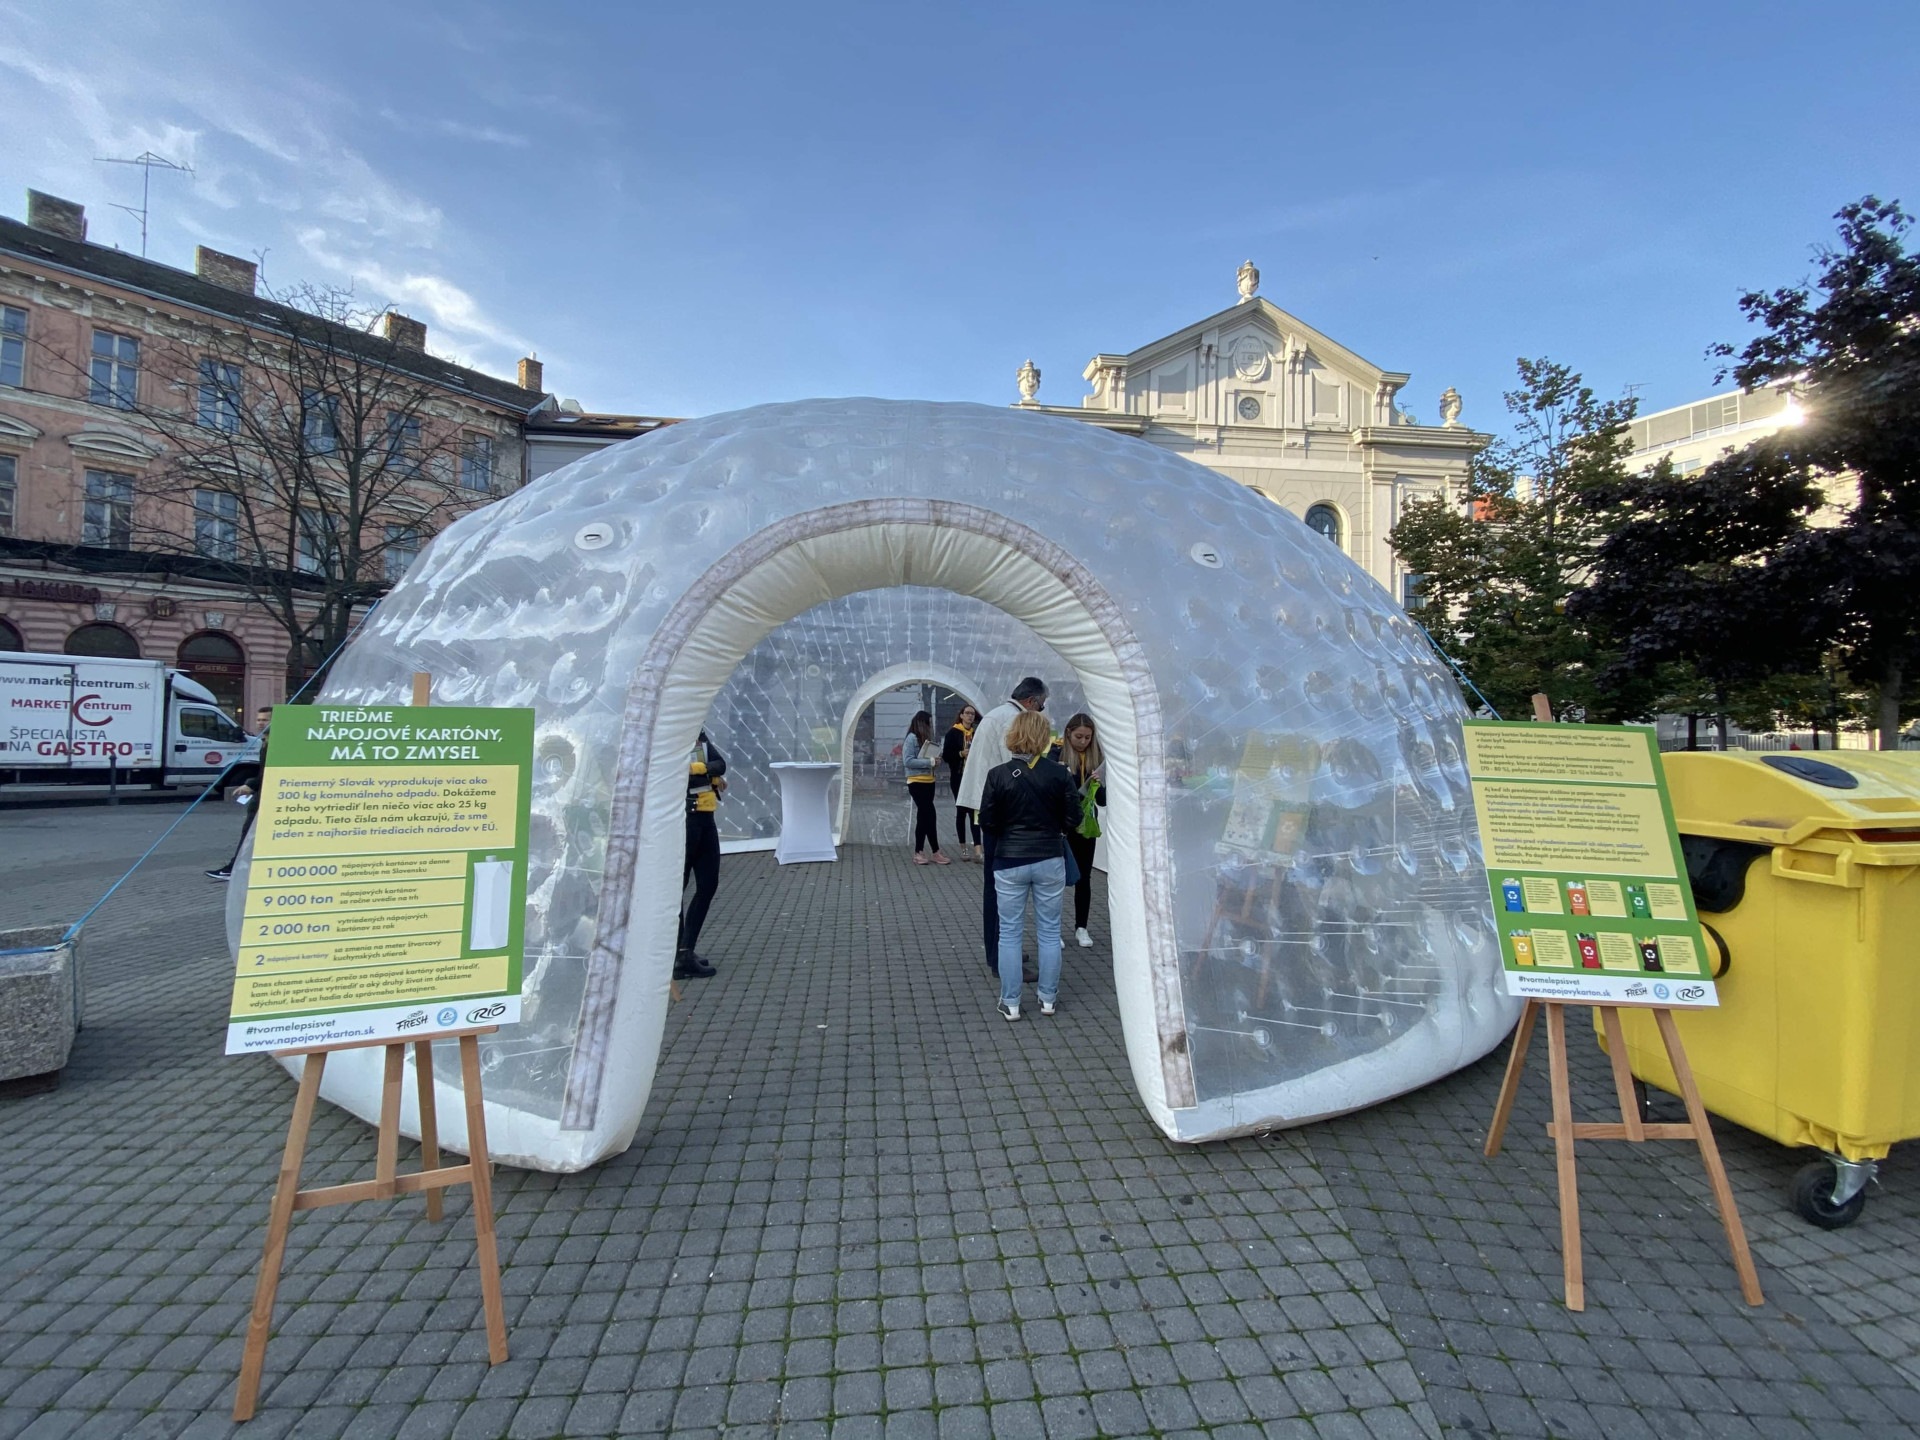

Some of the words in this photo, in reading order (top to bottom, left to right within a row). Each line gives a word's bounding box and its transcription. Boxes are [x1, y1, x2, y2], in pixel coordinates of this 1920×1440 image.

[11, 699, 72, 710] MARKET
[320, 708, 393, 722] TRIEĎME
[9, 726, 108, 741] ŠPECIALISTA
[307, 724, 411, 740] NÁPOJOVÉ
[416, 725, 503, 742] KARTÓNY,
[9, 742, 32, 751] NA
[37, 742, 133, 756] GASTRO
[330, 742, 366, 760] MÁ
[372, 746, 399, 760] TO
[405, 746, 480, 760] ZMYSEL
[280, 778, 336, 788] Priemerný
[339, 778, 375, 786] Slovák
[378, 777, 443, 788] vyprodukuje
[469, 777, 487, 785] ako
[277, 791, 300, 800] 300
[303, 791, 317, 801] kg
[320, 790, 393, 799] komunálneho
[396, 789, 440, 799] odpadu.
[443, 788, 496, 797] Dokážeme
[285, 803, 310, 812] toho
[314, 802, 361, 814] vytriediť
[363, 802, 379, 810] len
[382, 802, 410, 810] niečo
[413, 801, 433, 809] viac
[436, 801, 456, 809] ako
[458, 800, 471, 808] 25
[474, 800, 487, 809] kg
[274, 816, 322, 827] odpadu.
[325, 816, 351, 824] Tieto
[381, 814, 404, 822] nám
[407, 813, 450, 822] ukazujú,
[453, 812, 465, 820] že
[272, 830, 304, 840] jeden
[317, 827, 367, 838] najhoršie
[370, 825, 424, 836] triediacich
[427, 824, 470, 833] národov
[267, 868, 273, 878] 1
[263, 896, 273, 907] 9
[277, 895, 306, 906] 000
[310, 895, 333, 904] ton
[258, 925, 269, 936] 2
[273, 923, 303, 935] 000
[307, 923, 330, 933] ton
[255, 954, 265, 966] 2
[1520, 986, 1611, 997] www.napojovykarton.sk
[1624, 987, 1648, 998] FRESH
[246, 1019, 336, 1035] #tvormelepsisvet
[396, 1014, 428, 1032] FRESH
[244, 1025, 375, 1047] www.napojovykarton.sk
